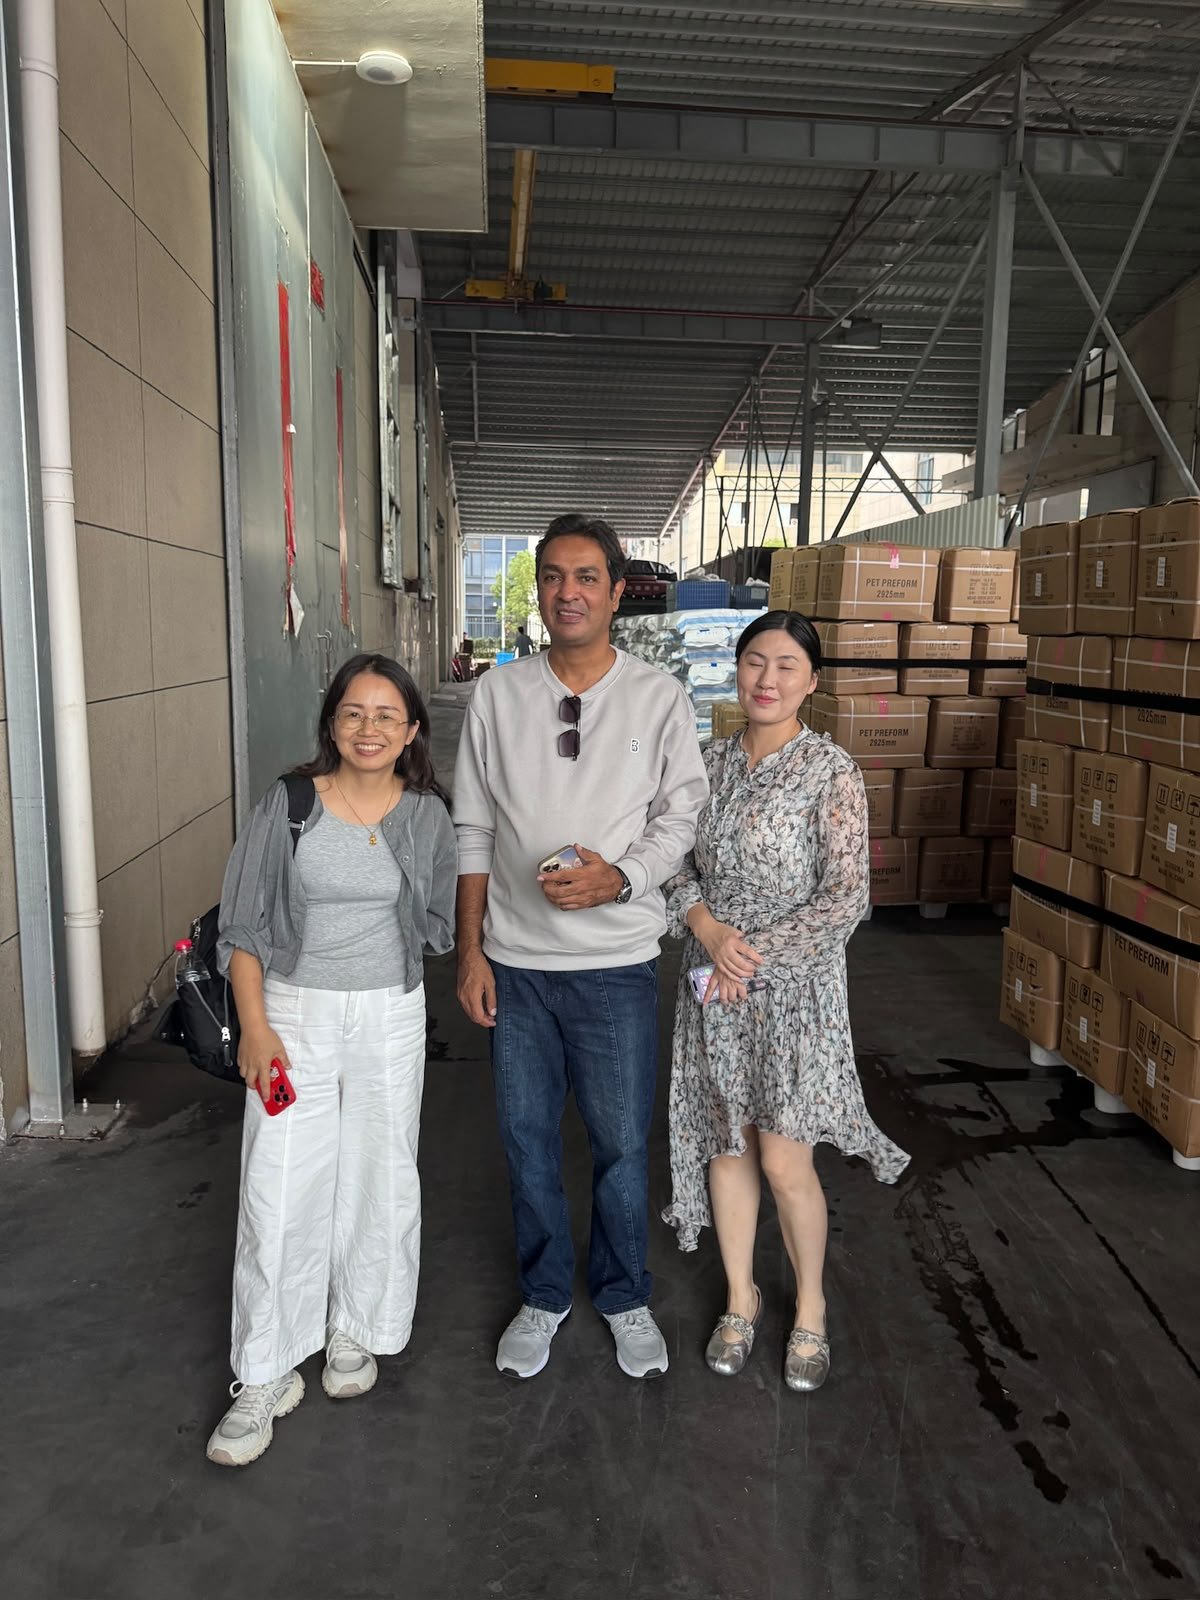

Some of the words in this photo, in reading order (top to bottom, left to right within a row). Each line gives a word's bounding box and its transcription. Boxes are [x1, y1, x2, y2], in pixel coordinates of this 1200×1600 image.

[866, 578, 880, 587] PET
[882, 578, 918, 588] PREFORM
[876, 590, 905, 598] 2925mm
[1137, 708, 1167, 726] 2925mm
[859, 729, 873, 737] PET
[874, 728, 909, 737] PREFORM
[869, 739, 897, 747] 2925mm
[1128, 942, 1169, 977] PREFORM
